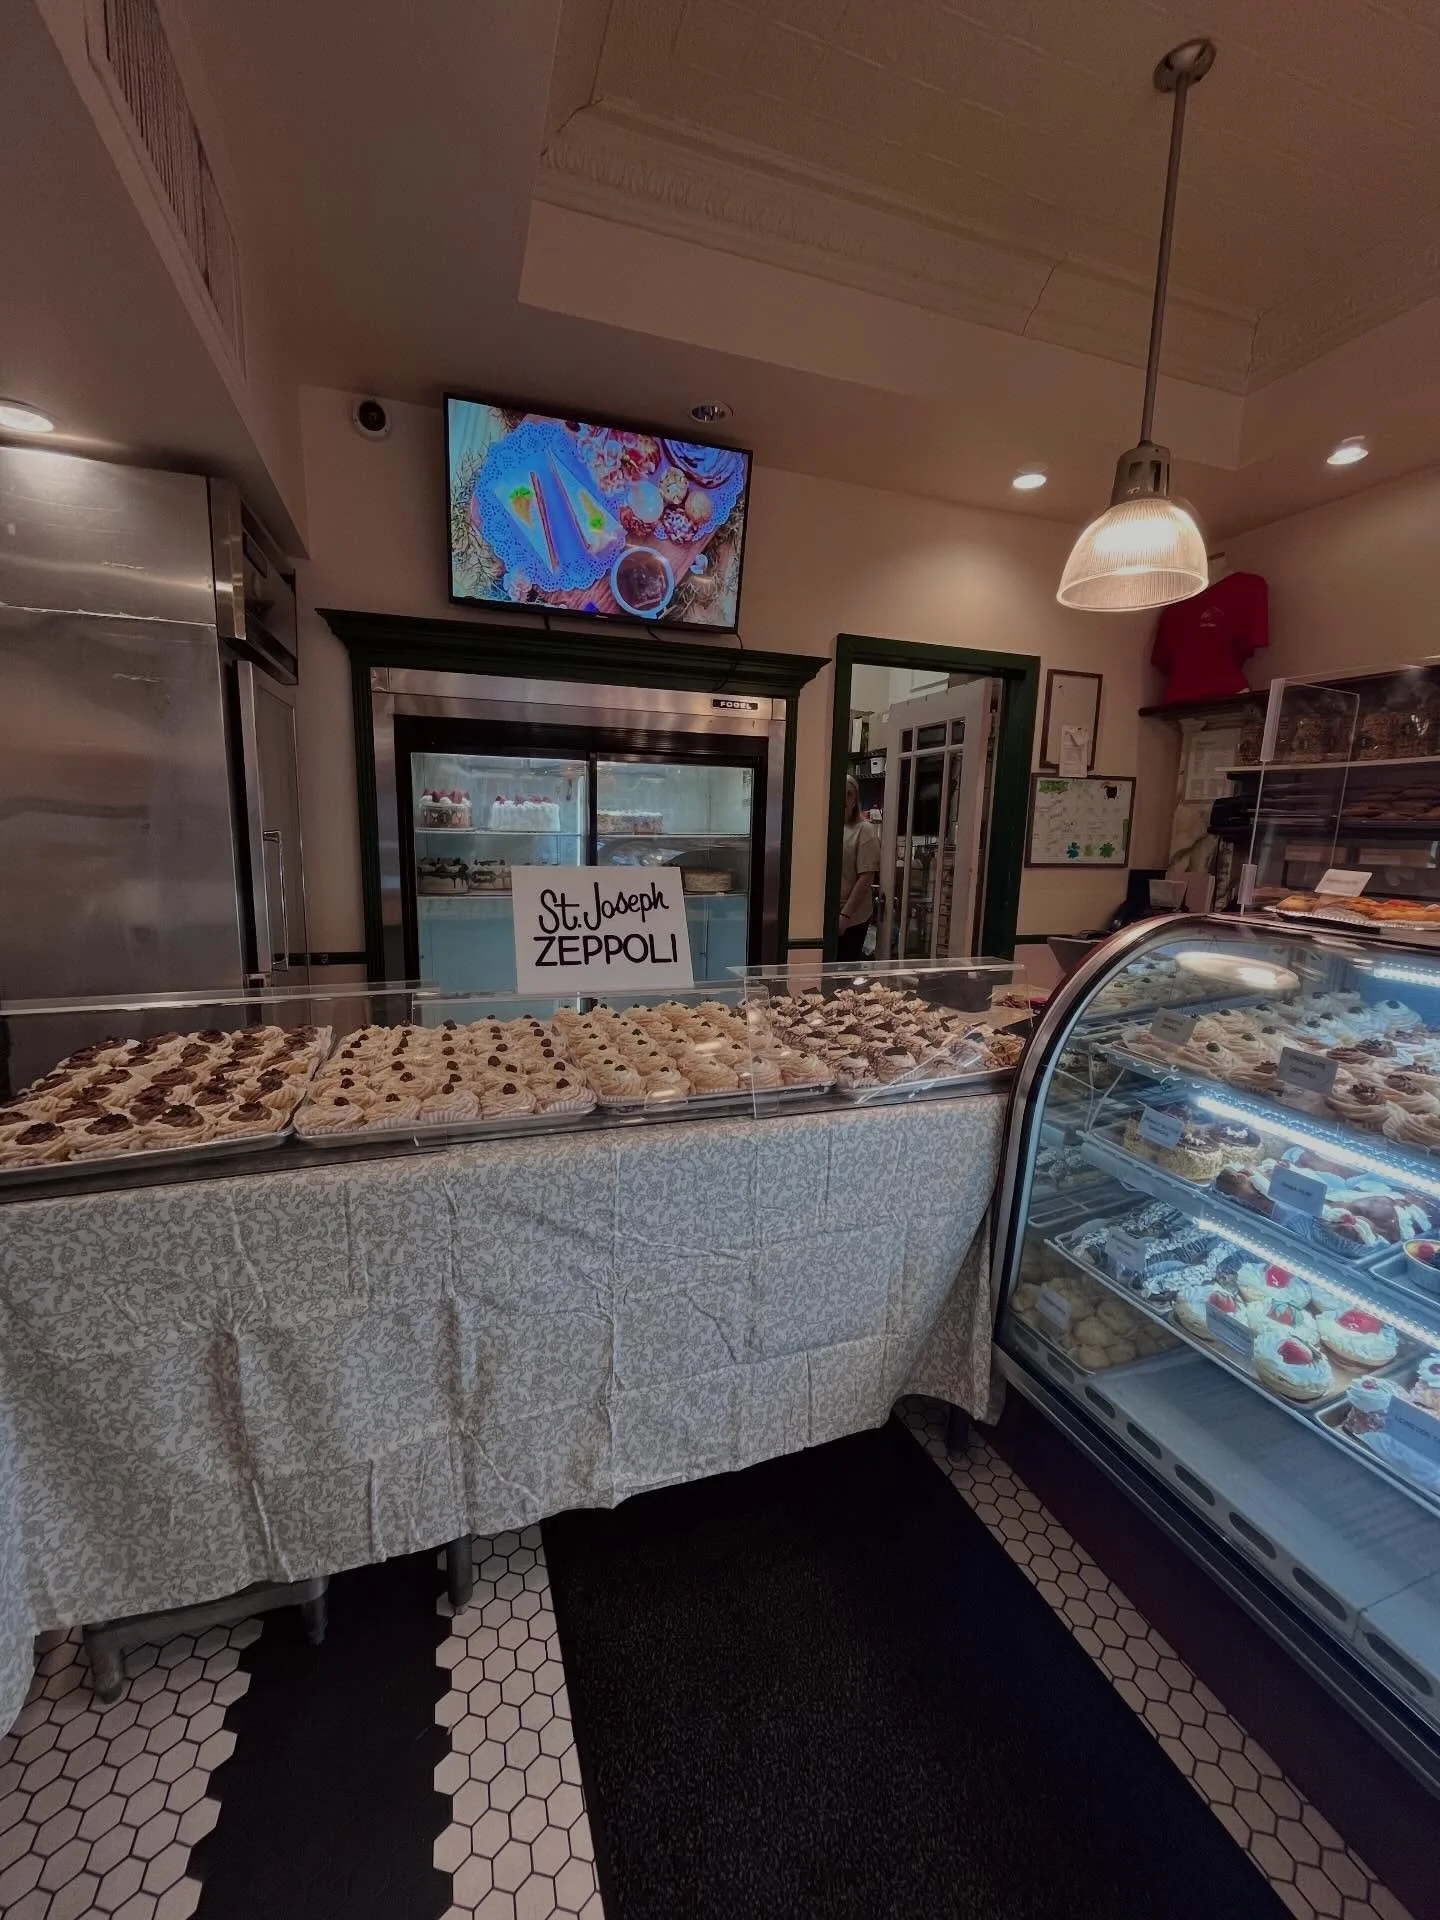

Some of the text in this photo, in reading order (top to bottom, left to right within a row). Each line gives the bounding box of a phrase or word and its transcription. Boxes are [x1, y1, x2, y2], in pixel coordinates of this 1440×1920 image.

[538, 881, 670, 934] St. Joseph
[533, 933, 678, 967] ZEPPOLI
